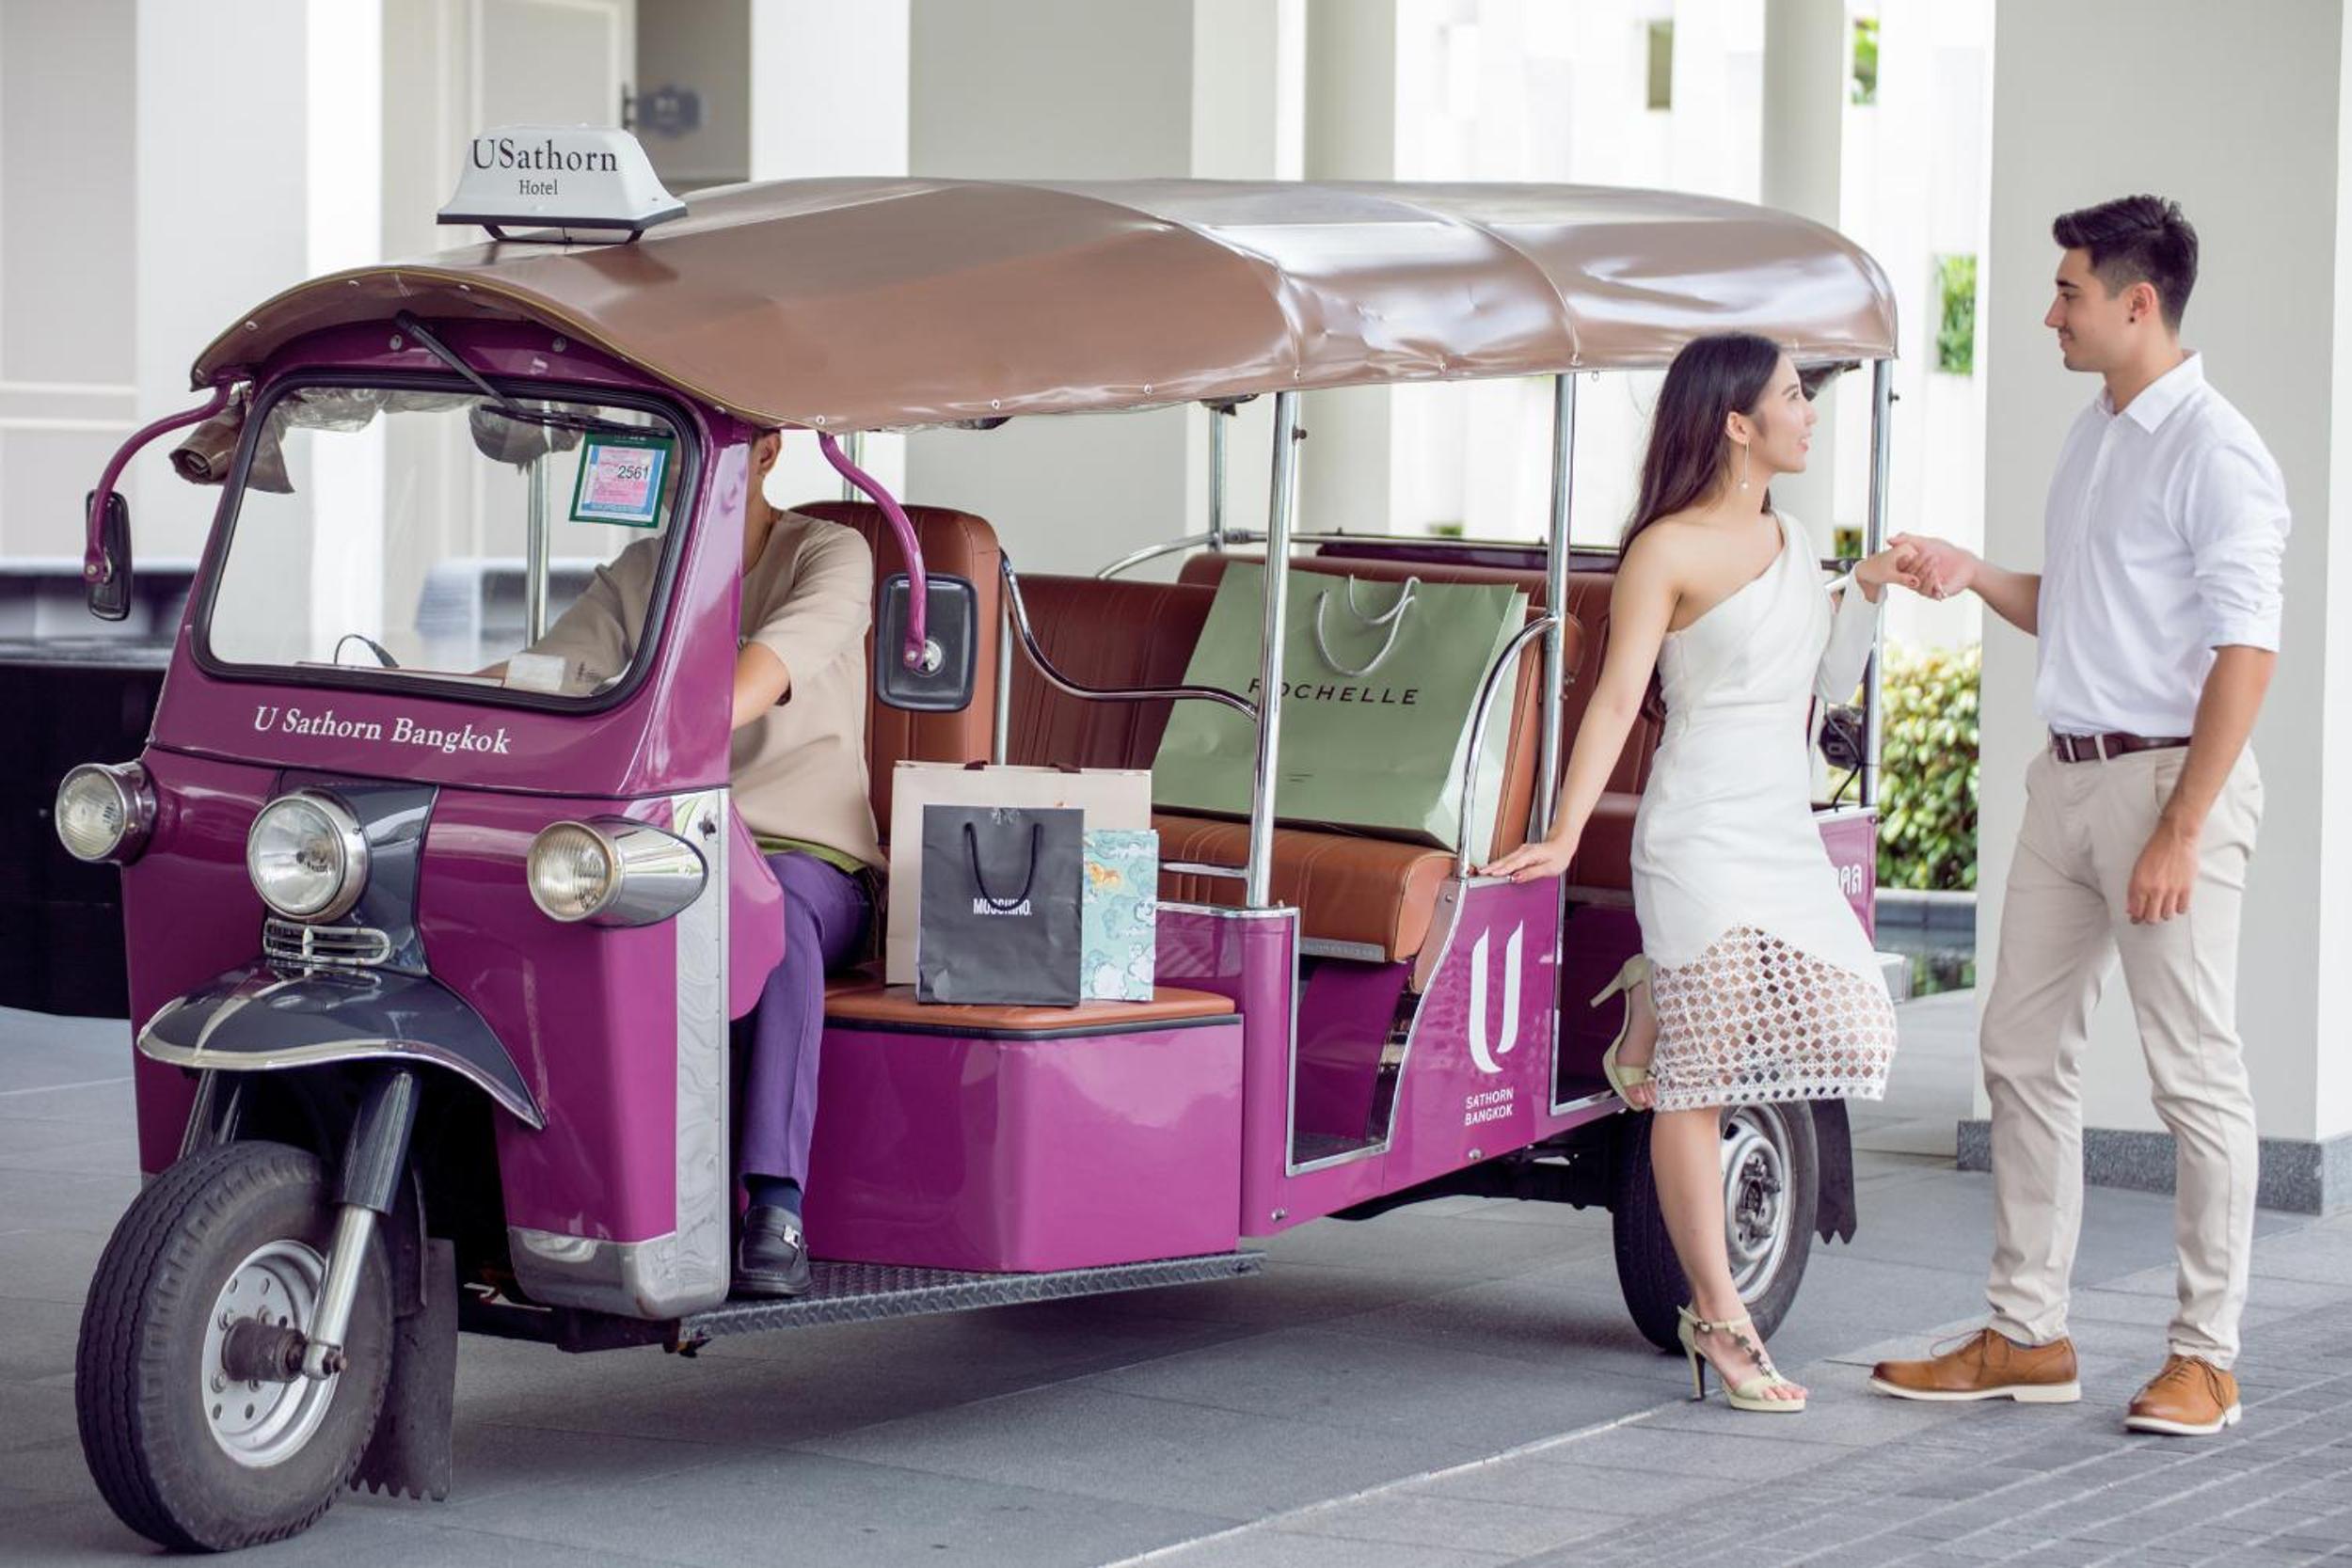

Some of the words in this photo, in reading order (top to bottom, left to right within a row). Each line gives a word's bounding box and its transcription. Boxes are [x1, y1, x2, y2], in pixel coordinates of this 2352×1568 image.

[518, 180, 558, 196] Hotel
[617, 465, 649, 480] 2561
[254, 705, 279, 731] U
[282, 708, 382, 741] Sathorn
[390, 717, 512, 754] Bangkok
[1465, 1086, 1514, 1110] SATHORN
[1465, 1103, 1514, 1127] BANGKOK
